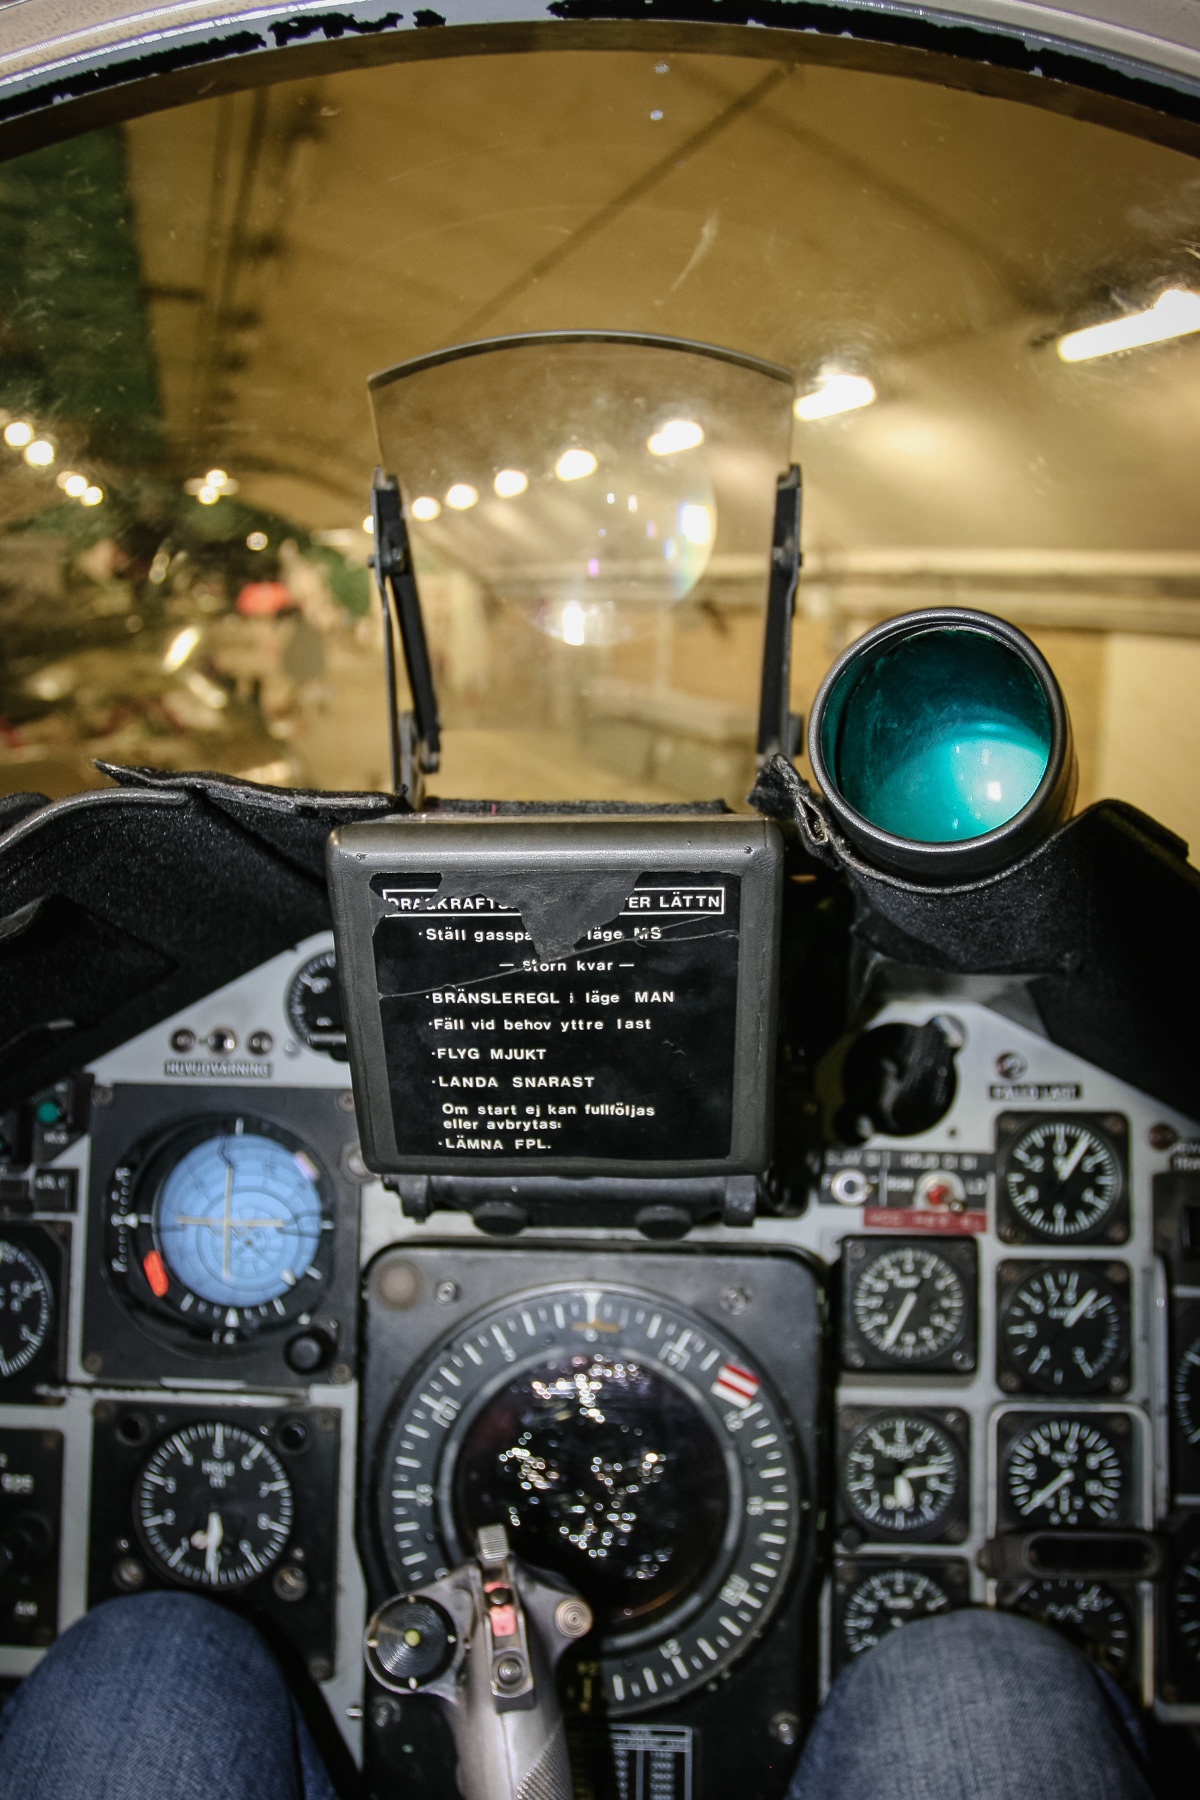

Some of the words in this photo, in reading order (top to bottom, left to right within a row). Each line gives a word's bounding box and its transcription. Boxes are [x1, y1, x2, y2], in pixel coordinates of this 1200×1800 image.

[659, 891, 720, 908] LÄTTN
[426, 926, 468, 942] Ställ
[473, 930, 533, 944] gasspa
[586, 926, 624, 942] läge
[576, 960, 614, 972] kvar
[432, 988, 560, 1004] BRÄNSLEREGL
[569, 992, 574, 1004] i
[585, 990, 620, 1006] läge
[634, 991, 674, 1003] MAN
[433, 1017, 464, 1031] Fäll
[471, 1019, 495, 1031] vid
[503, 1019, 552, 1031] behov
[560, 1019, 604, 1033] yttre
[616, 1018, 651, 1030] last
[436, 1047, 480, 1060] FLYG
[490, 1048, 547, 1061] MJUKT
[438, 1076, 499, 1088] LANDA
[512, 1076, 595, 1088] SNARAST
[441, 1102, 469, 1115] Om
[477, 1104, 517, 1116] start
[525, 1105, 541, 1118] ej
[547, 1104, 577, 1115] kan
[584, 1102, 655, 1118] fullföljas
[442, 1118, 479, 1130] eller
[486, 1119, 562, 1132] avbrytas:
[445, 1134, 504, 1150] LÄMNA
[514, 1138, 551, 1150] FPL.
